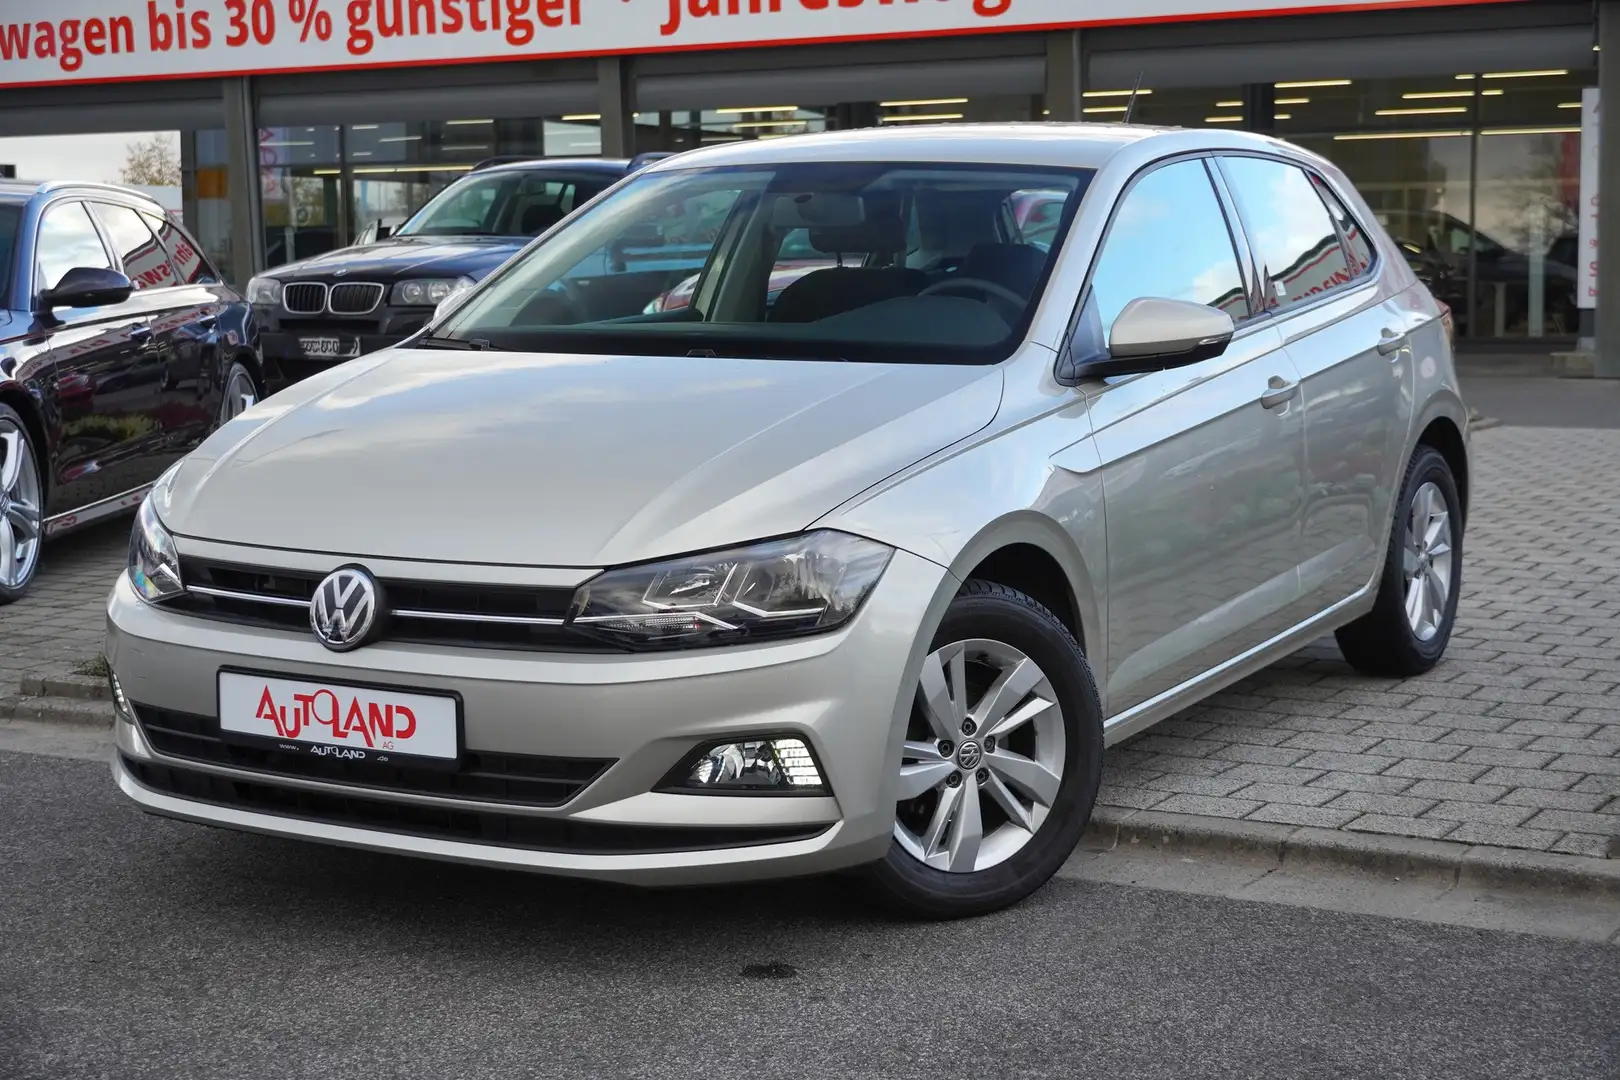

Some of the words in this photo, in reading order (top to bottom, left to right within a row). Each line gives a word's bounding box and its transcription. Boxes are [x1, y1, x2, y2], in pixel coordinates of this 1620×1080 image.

[0, 15, 136, 72] wagen
[147, 0, 213, 52] bis
[226, 0, 276, 47] 30
[288, 0, 333, 42] %
[310, 568, 375, 644] VW
[255, 684, 417, 748] AUTOLAND
[382, 740, 394, 751] AG
[310, 745, 366, 760] AUTOLAND
